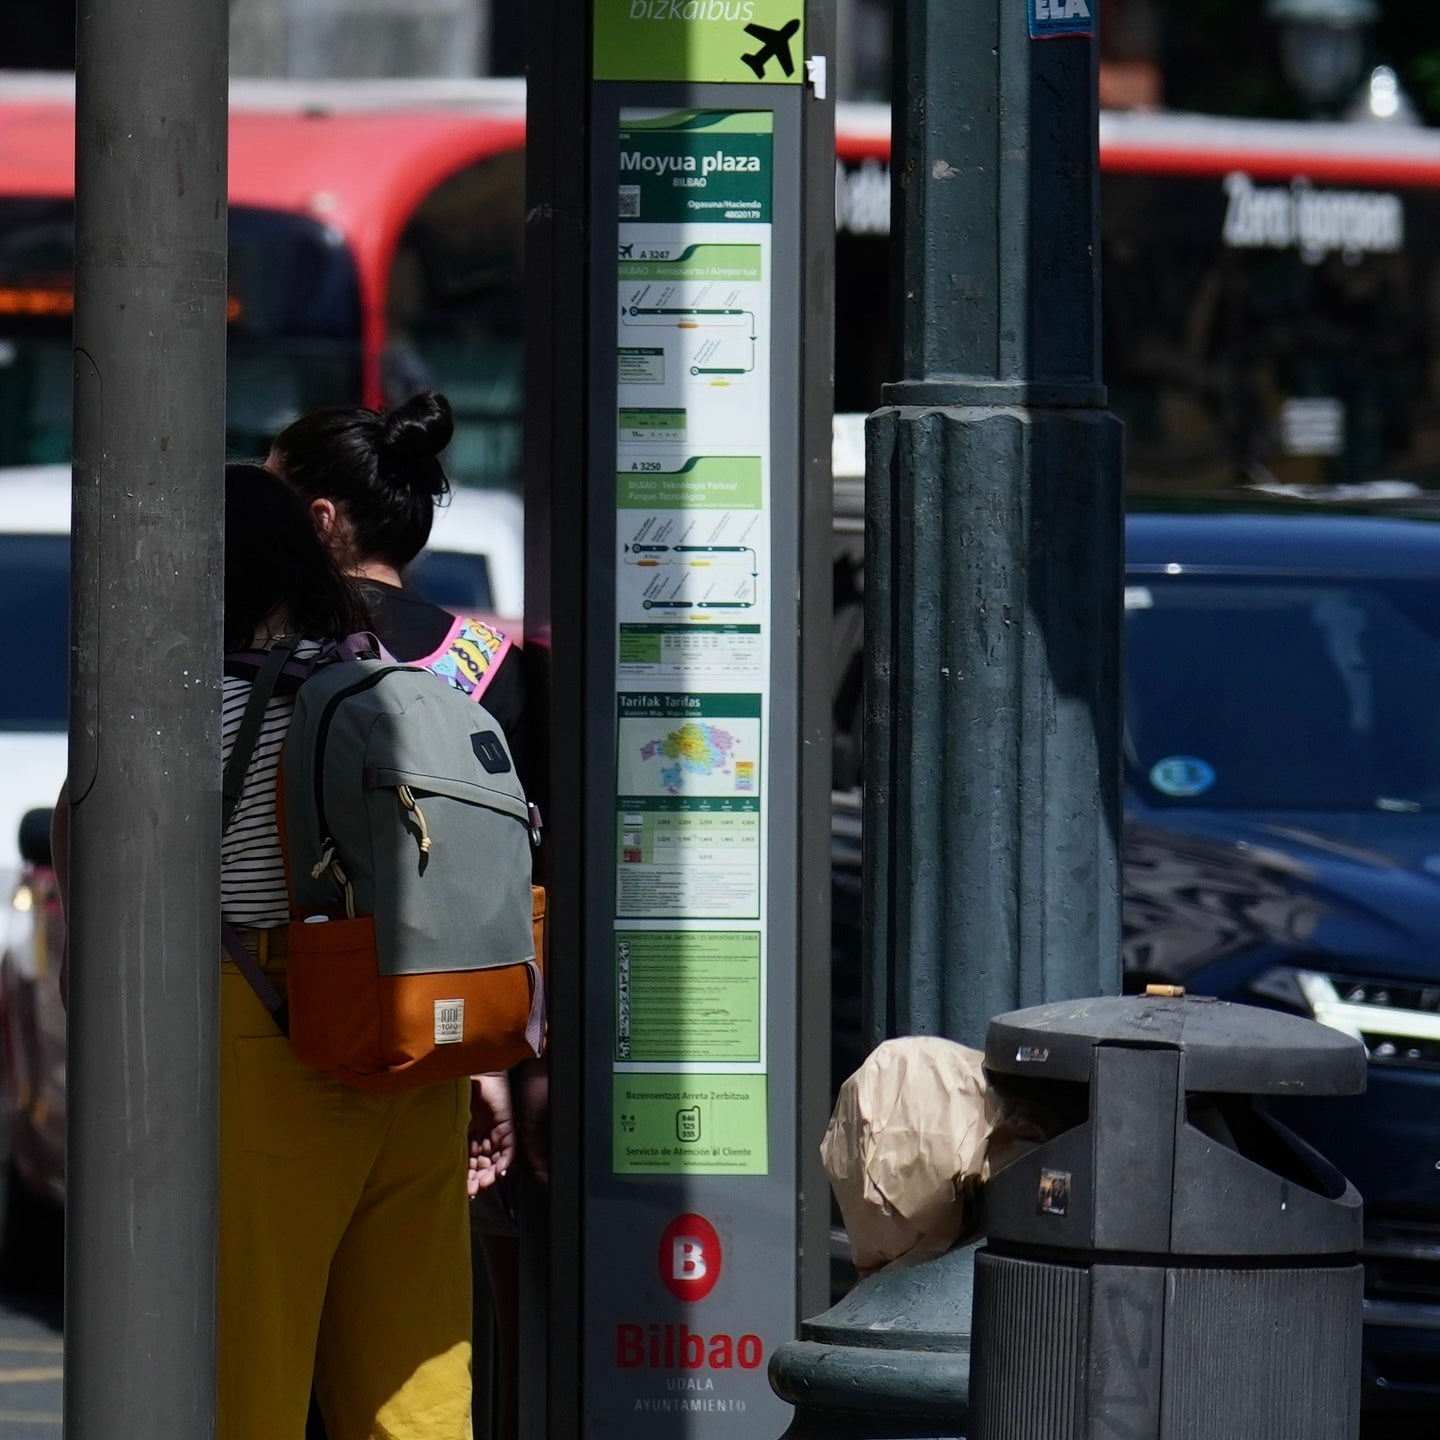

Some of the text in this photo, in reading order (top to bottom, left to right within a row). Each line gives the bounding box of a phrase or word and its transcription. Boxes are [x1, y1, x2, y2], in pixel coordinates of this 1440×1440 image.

[619, 150, 761, 176] Moyua plaza
[672, 177, 707, 188] BILBAO
[640, 250, 647, 259] A
[632, 462, 661, 471] A 3250
[620, 695, 661, 708] Tarifak
[626, 1147, 659, 1156] Servicio
[661, 1147, 672, 1156] de
[722, 1148, 752, 1156] Cliente
[616, 1323, 764, 1370] Bilbao
[667, 1378, 714, 1391] UDALA
[633, 1399, 747, 1412] AYUNTAMIENTO
